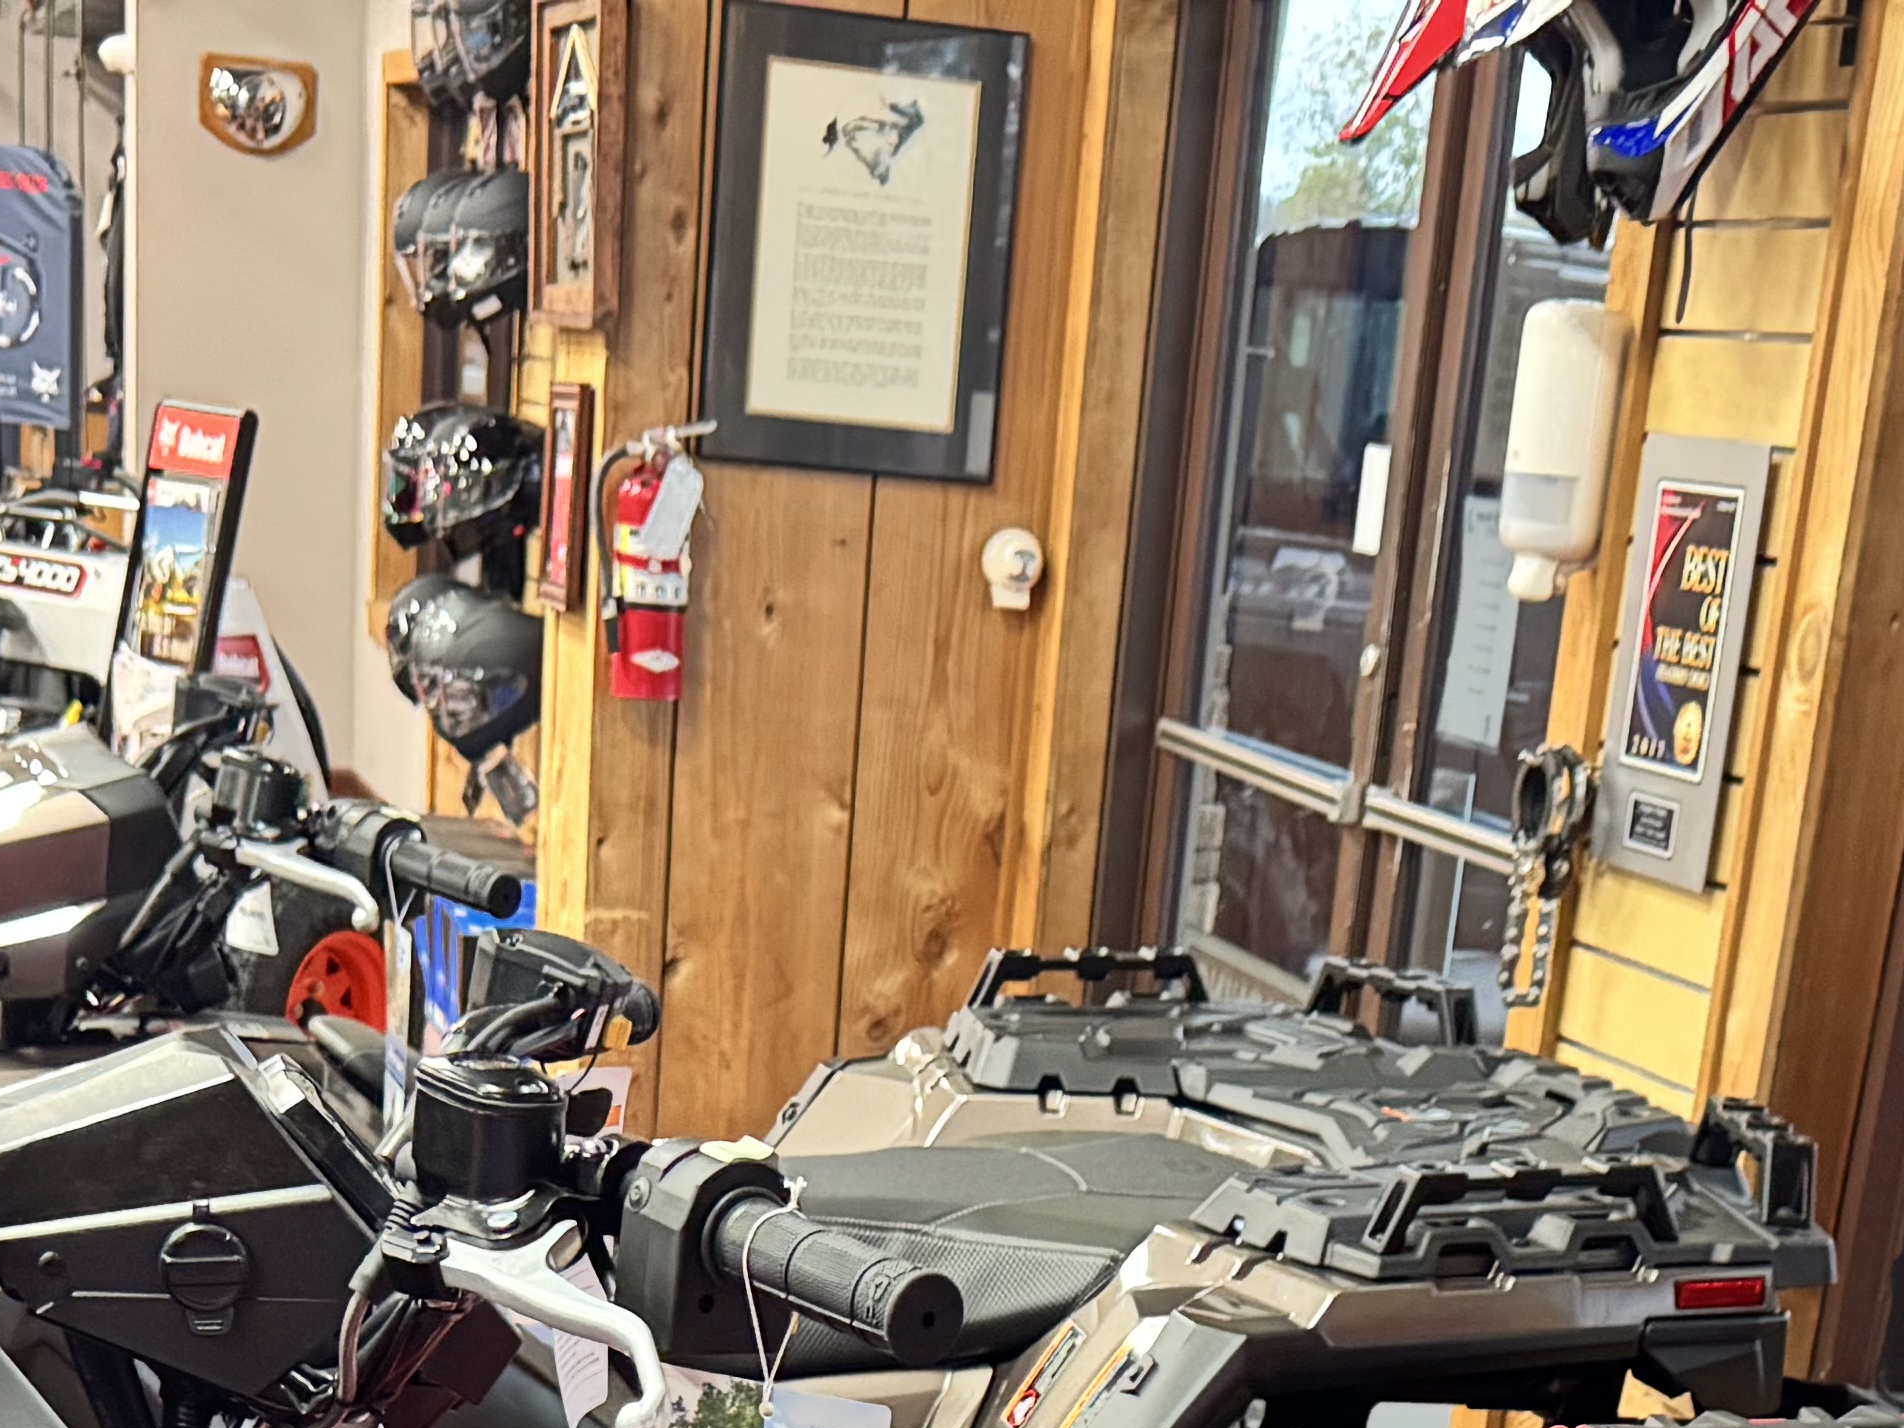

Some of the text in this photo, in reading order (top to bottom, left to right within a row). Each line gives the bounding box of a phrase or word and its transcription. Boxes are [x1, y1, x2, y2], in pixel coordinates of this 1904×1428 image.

[176, 424, 227, 464] Bobcat
[1681, 545, 1730, 596] BEST
[1682, 632, 1718, 671] BEST
